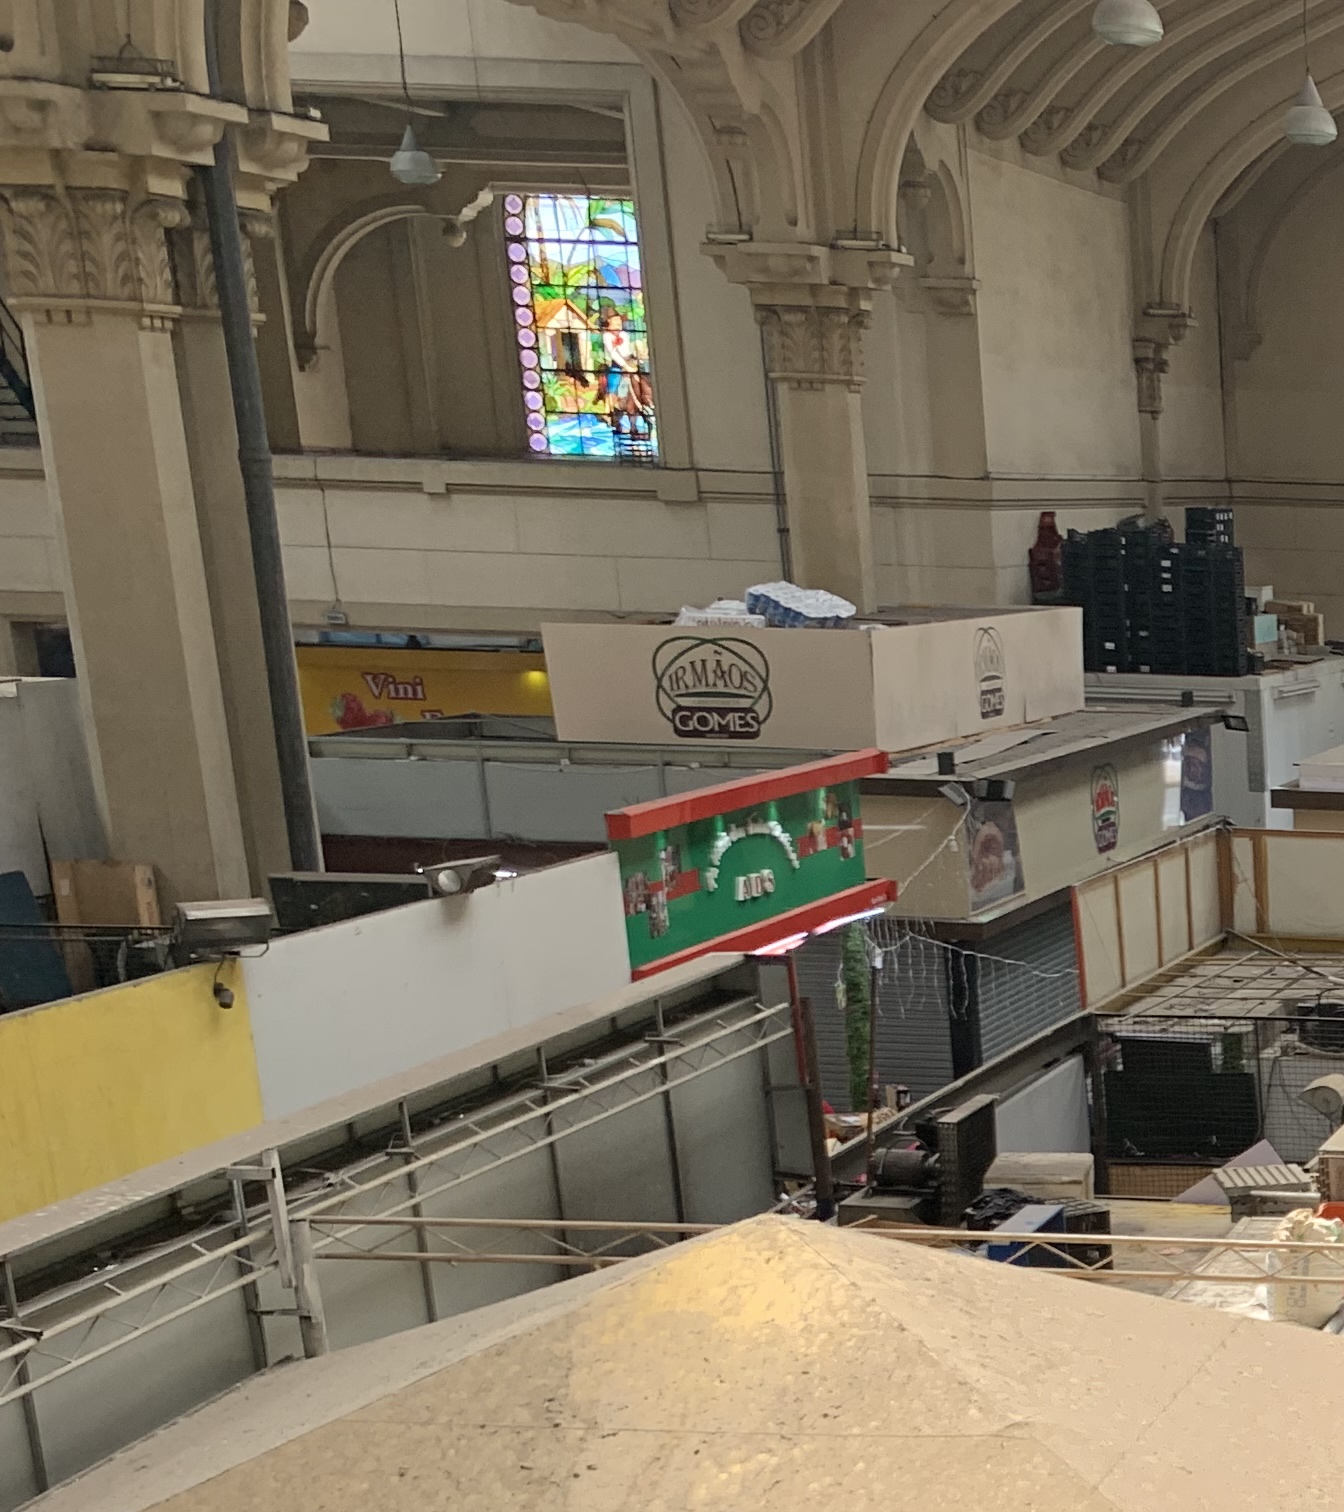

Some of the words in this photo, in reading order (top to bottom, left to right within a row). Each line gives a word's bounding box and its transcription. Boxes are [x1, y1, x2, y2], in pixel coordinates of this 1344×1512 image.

[668, 650, 758, 693] IRMÃOS
[362, 672, 427, 701] Vini
[674, 710, 760, 733] GOMES
